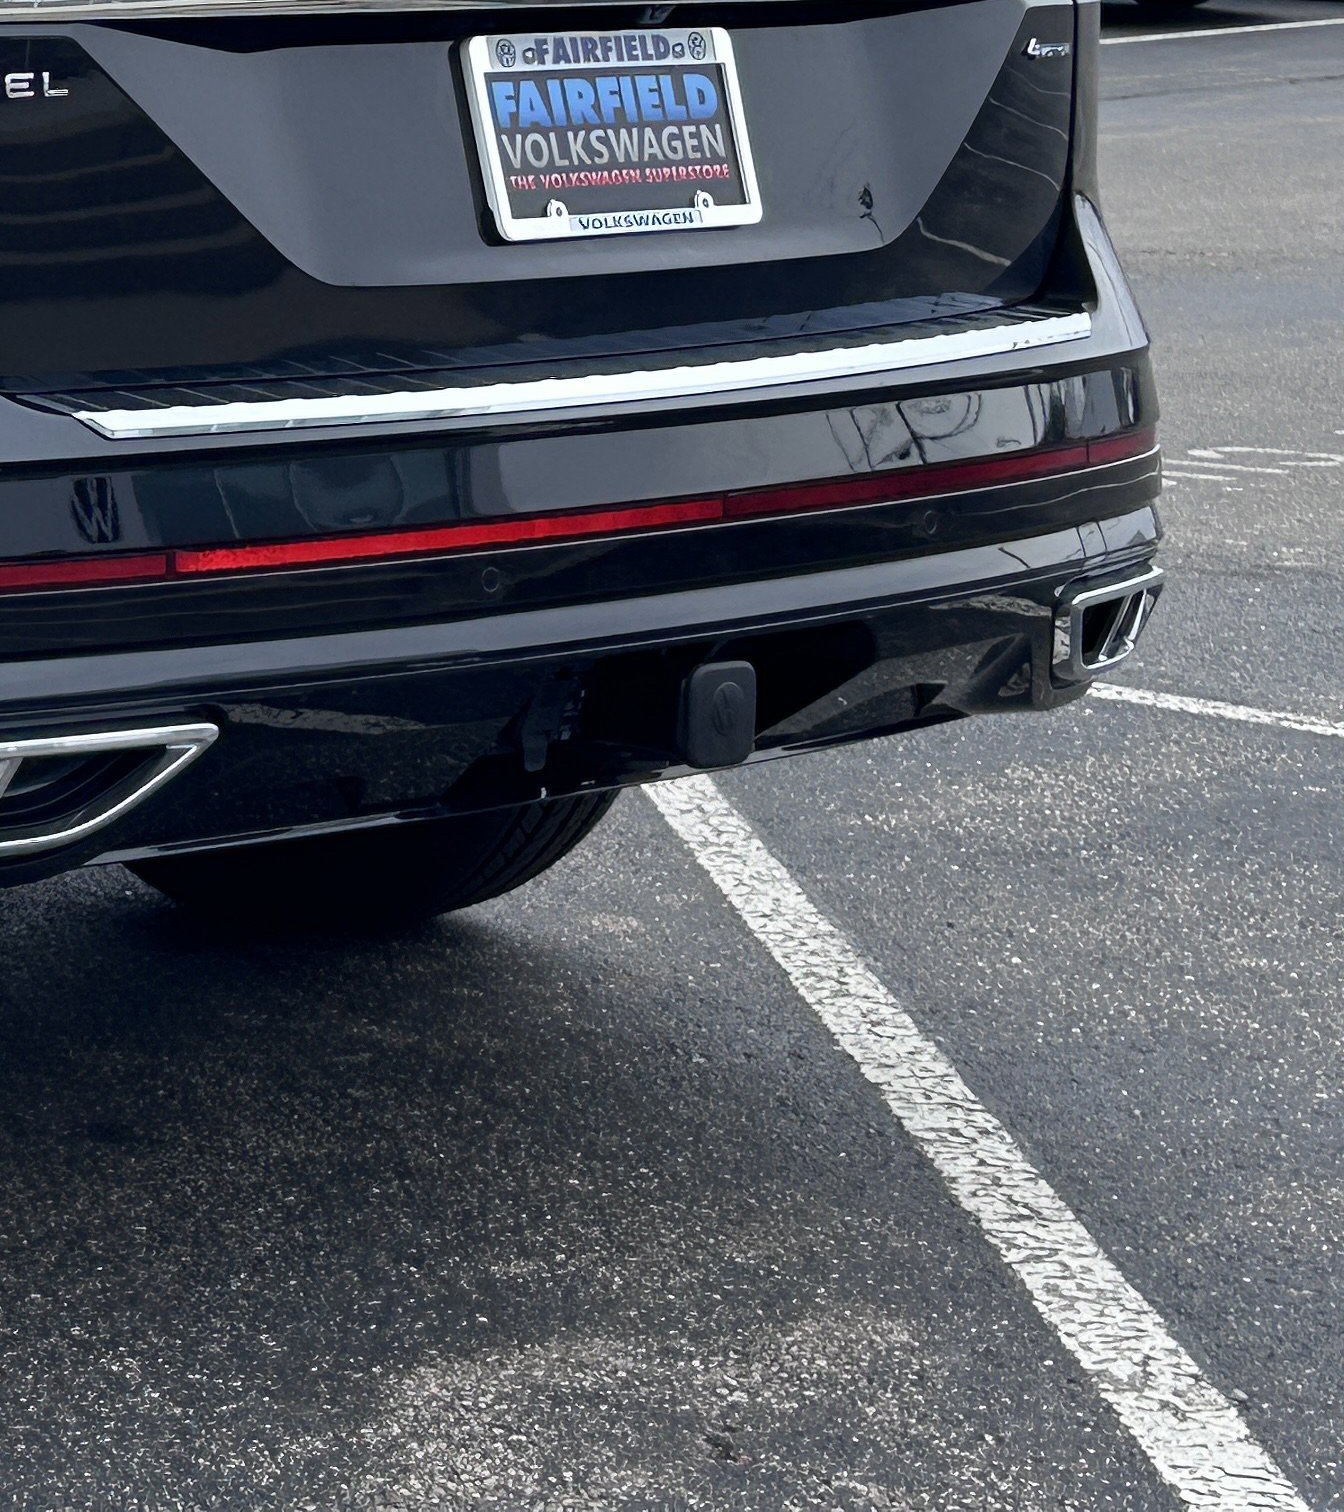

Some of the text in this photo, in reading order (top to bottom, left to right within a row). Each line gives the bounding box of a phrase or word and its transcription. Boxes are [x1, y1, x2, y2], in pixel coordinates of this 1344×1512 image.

[534, 34, 671, 65] FAIRFIELD
[491, 72, 718, 129] FAIRFIELD
[500, 123, 726, 169] VOLKSWAGEN
[510, 163, 730, 190] THE VOLKSWAGEN SUPERSTORE
[577, 211, 695, 230] VOLKSWAGEN
